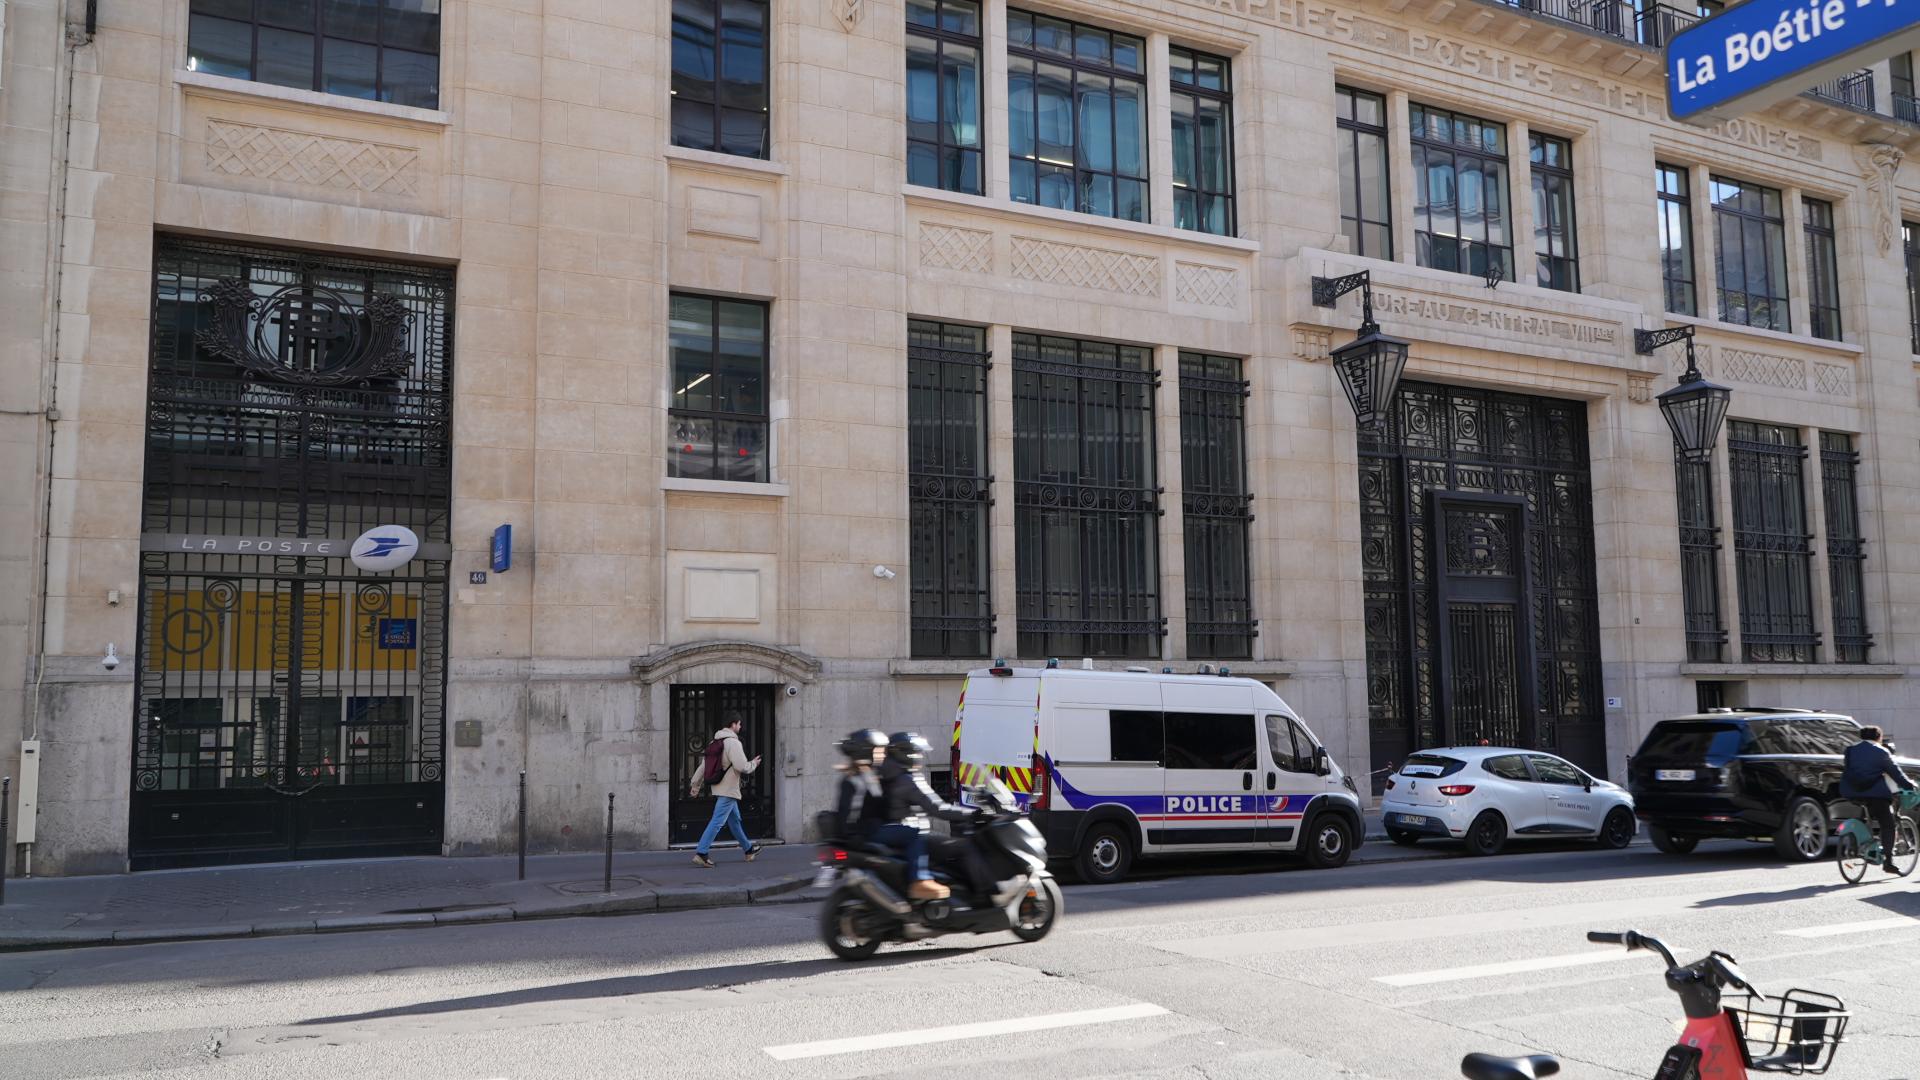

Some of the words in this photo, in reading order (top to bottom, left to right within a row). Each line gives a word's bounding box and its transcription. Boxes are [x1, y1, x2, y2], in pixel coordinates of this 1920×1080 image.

[1410, 32, 1553, 91] POSTES
[1677, 53, 1717, 94] La
[1725, 0, 1846, 74] Boétie
[1357, 289, 1450, 321] UREAU
[1463, 306, 1562, 338] CENTRAL
[181, 537, 217, 551] LA
[237, 540, 332, 554] POSTE
[471, 572, 485, 584] 49
[1167, 796, 1242, 813] POLICE
